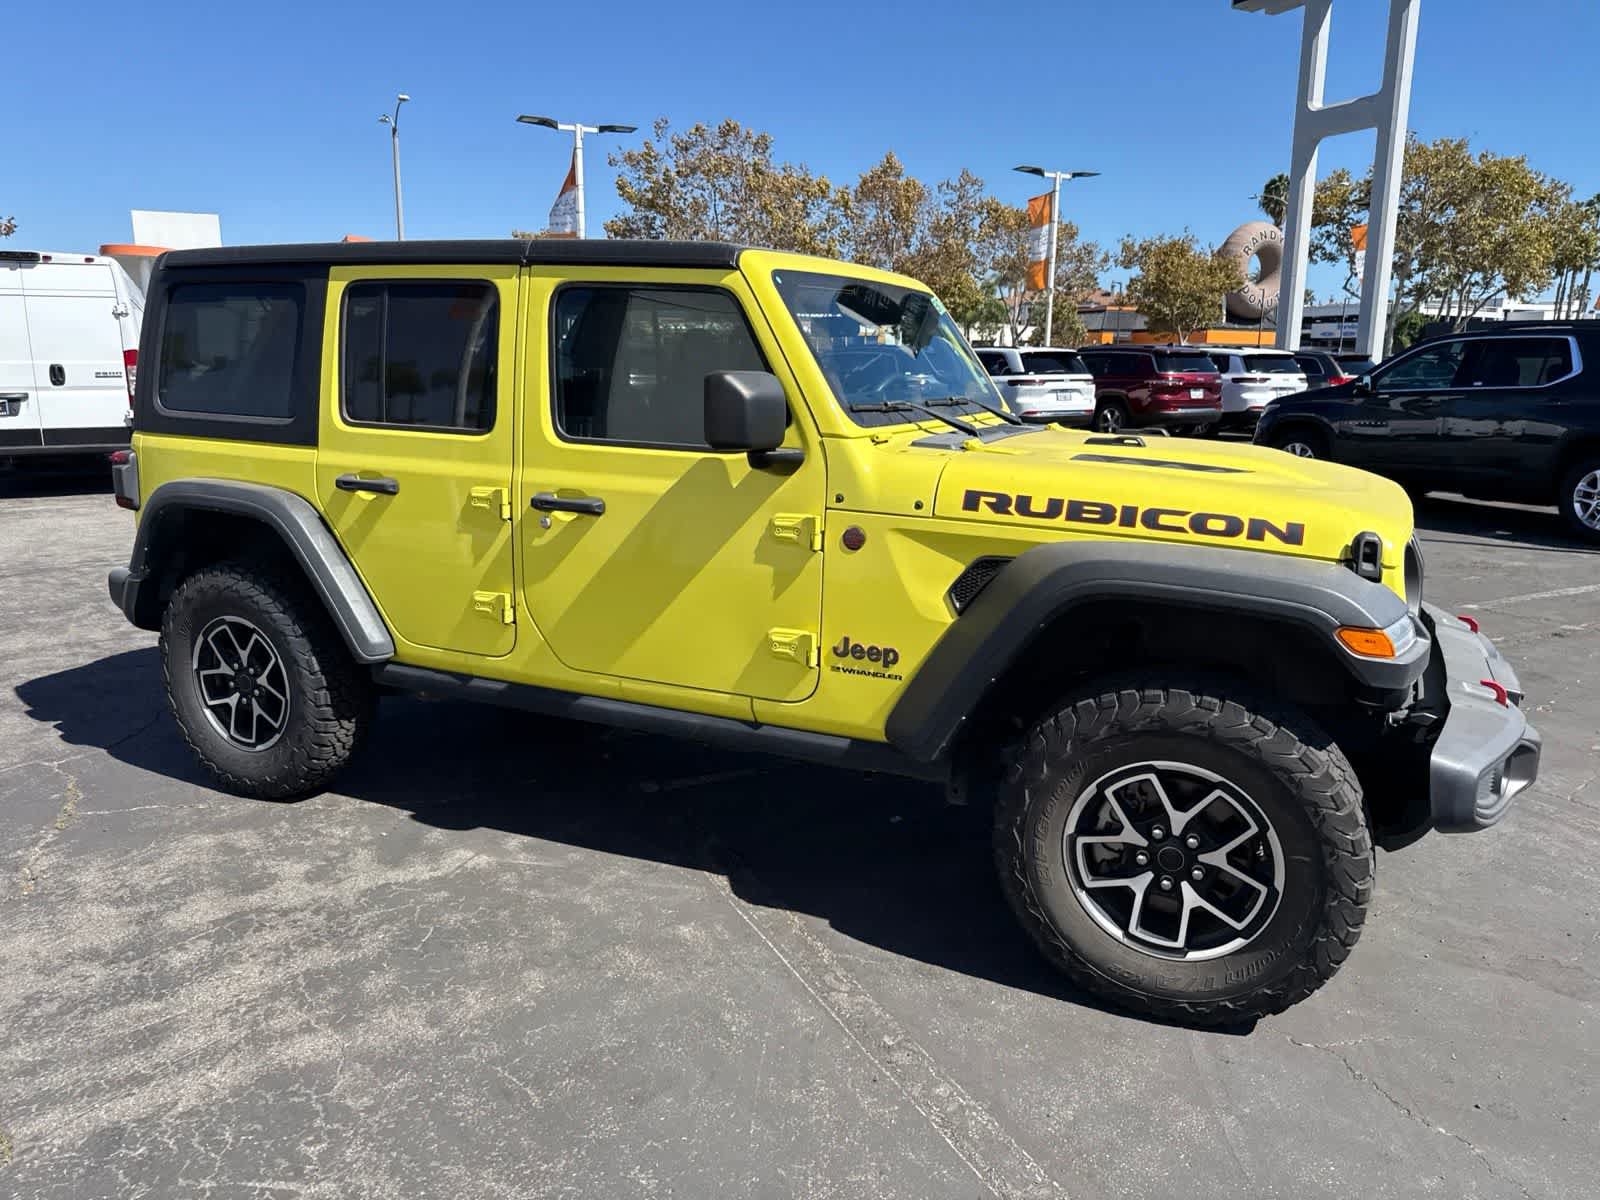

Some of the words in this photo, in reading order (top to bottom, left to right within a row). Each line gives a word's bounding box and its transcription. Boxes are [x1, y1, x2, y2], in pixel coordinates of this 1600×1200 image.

[962, 490, 1305, 546] RUBICON
[832, 636, 900, 668] Jeep
[842, 666, 903, 681] WRANGLER
